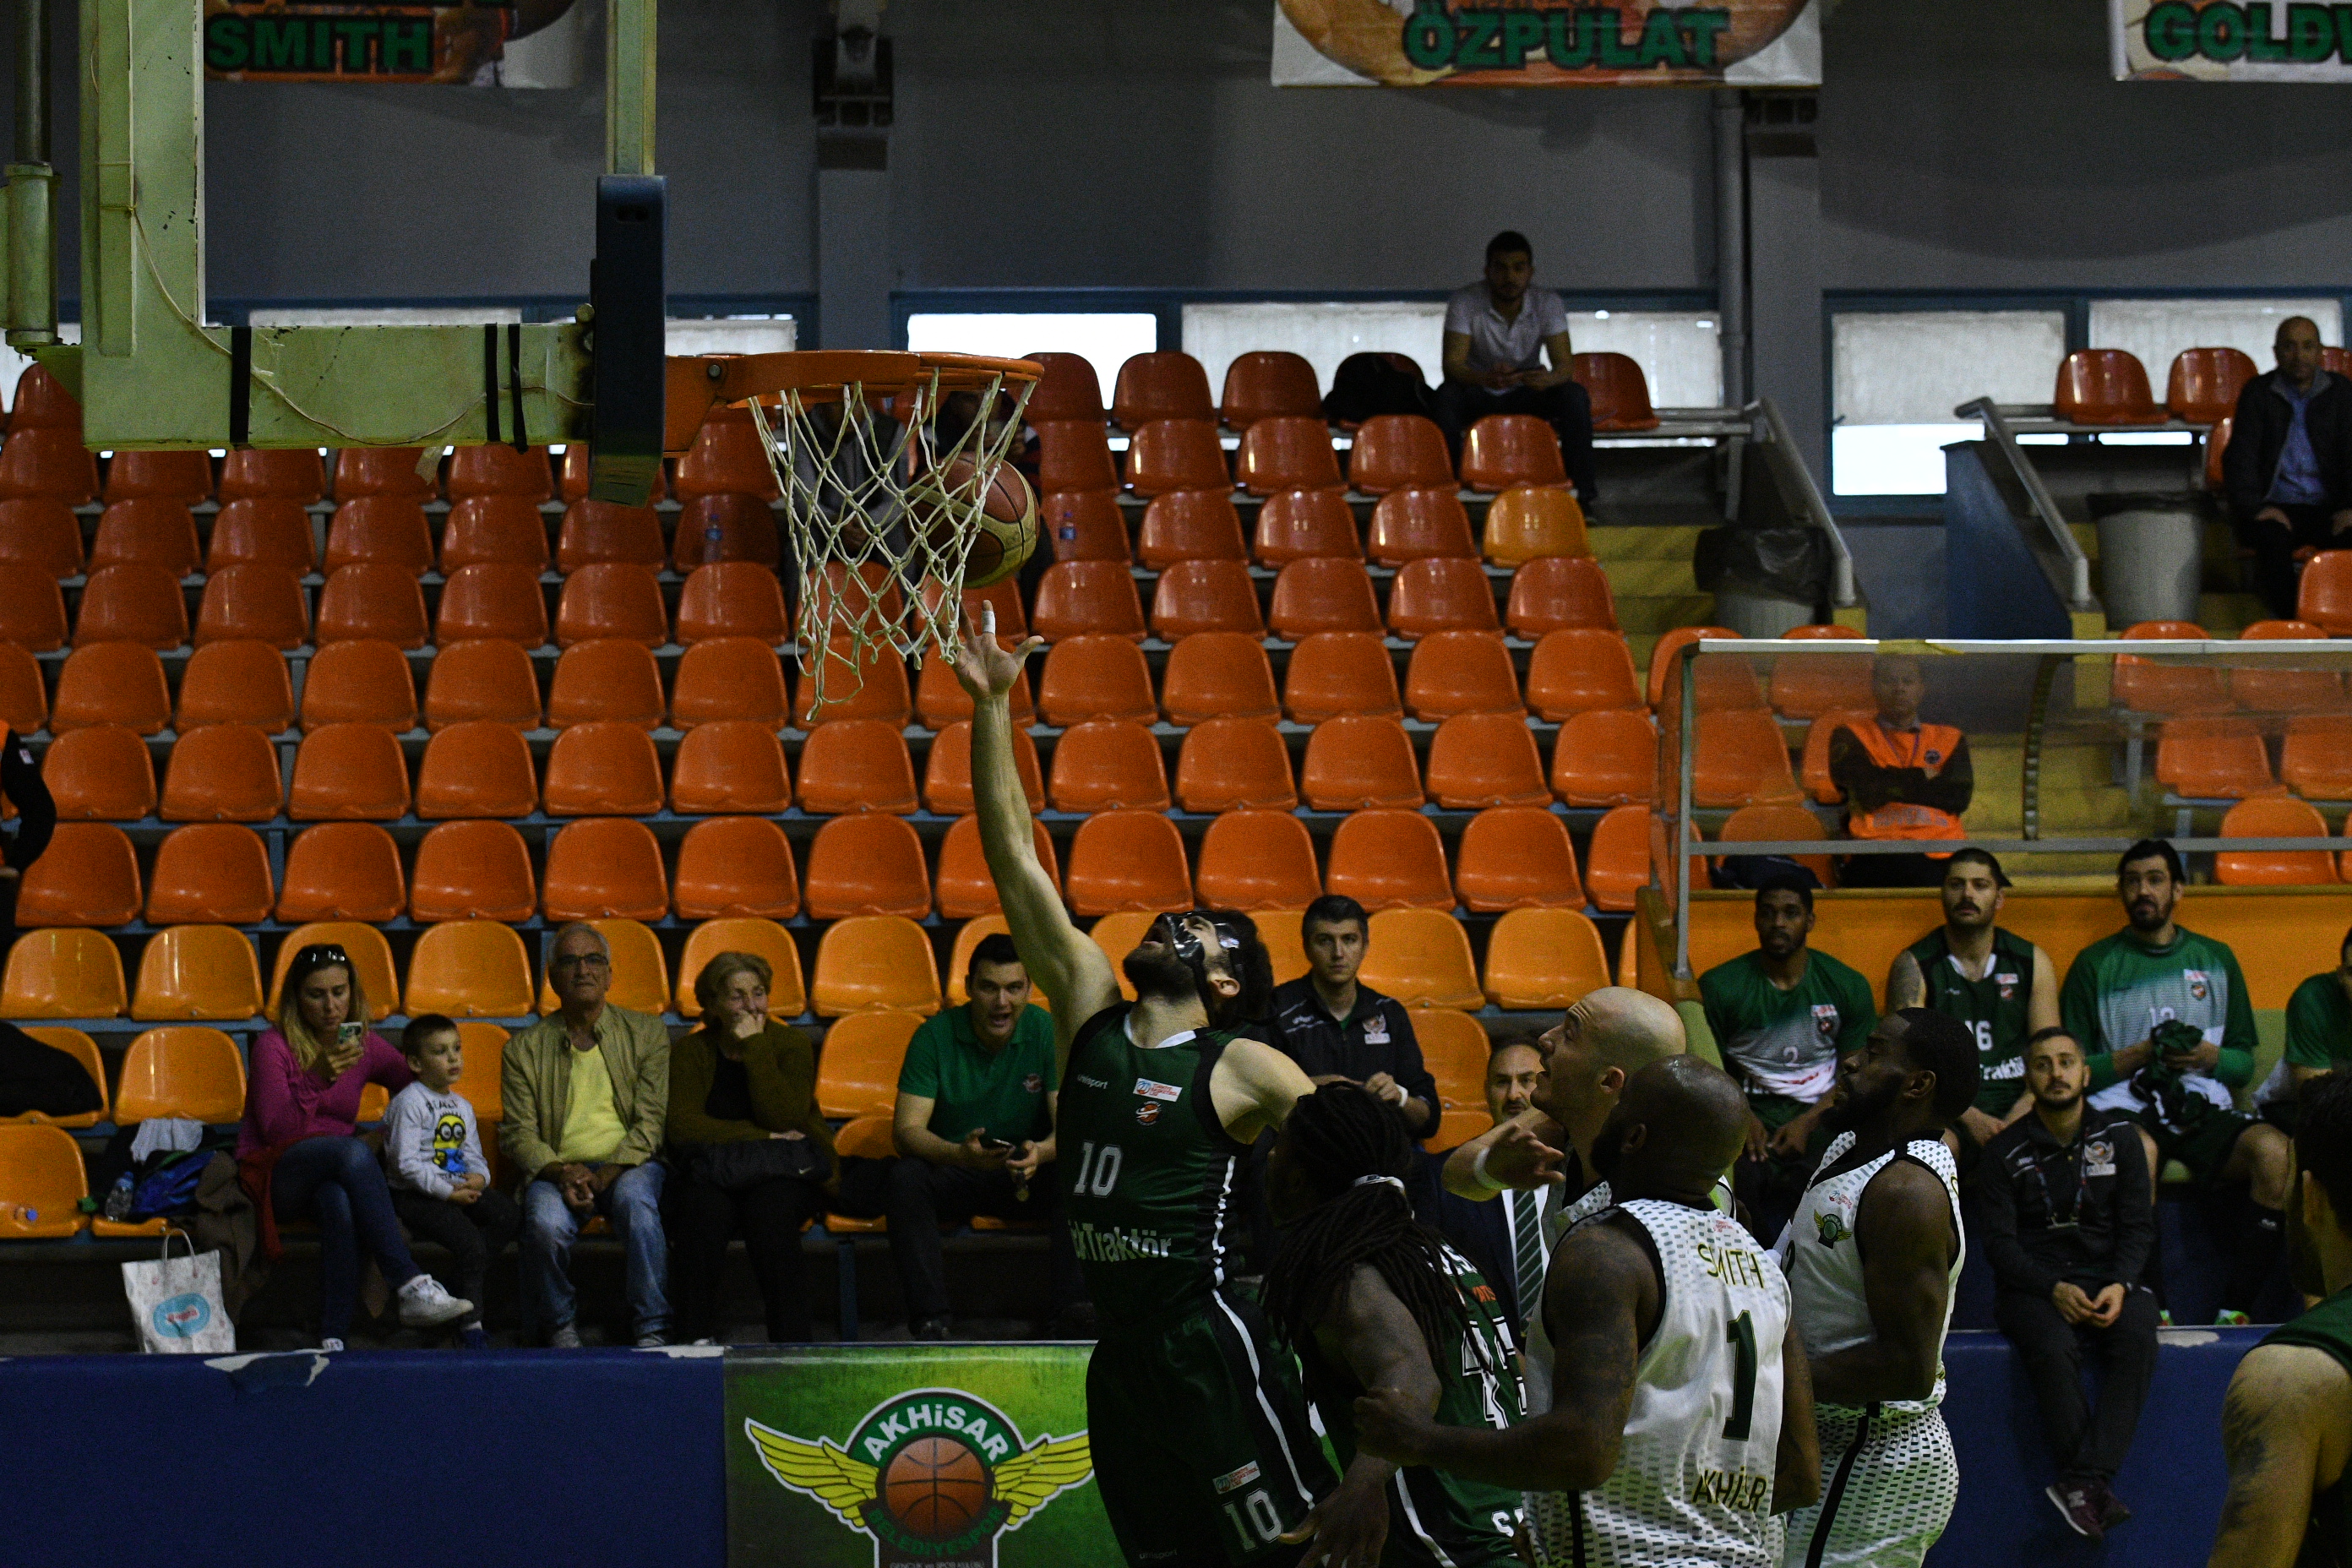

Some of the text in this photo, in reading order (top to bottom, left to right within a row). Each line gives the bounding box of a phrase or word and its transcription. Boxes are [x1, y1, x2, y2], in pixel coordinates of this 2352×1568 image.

[204, 13, 434, 74] SMITH
[1402, 0, 1730, 70] ÖZPULAT
[1073, 1141, 1124, 1199] 10
[1722, 1309, 1758, 1441] 1
[1222, 1488, 1283, 1552] 10
